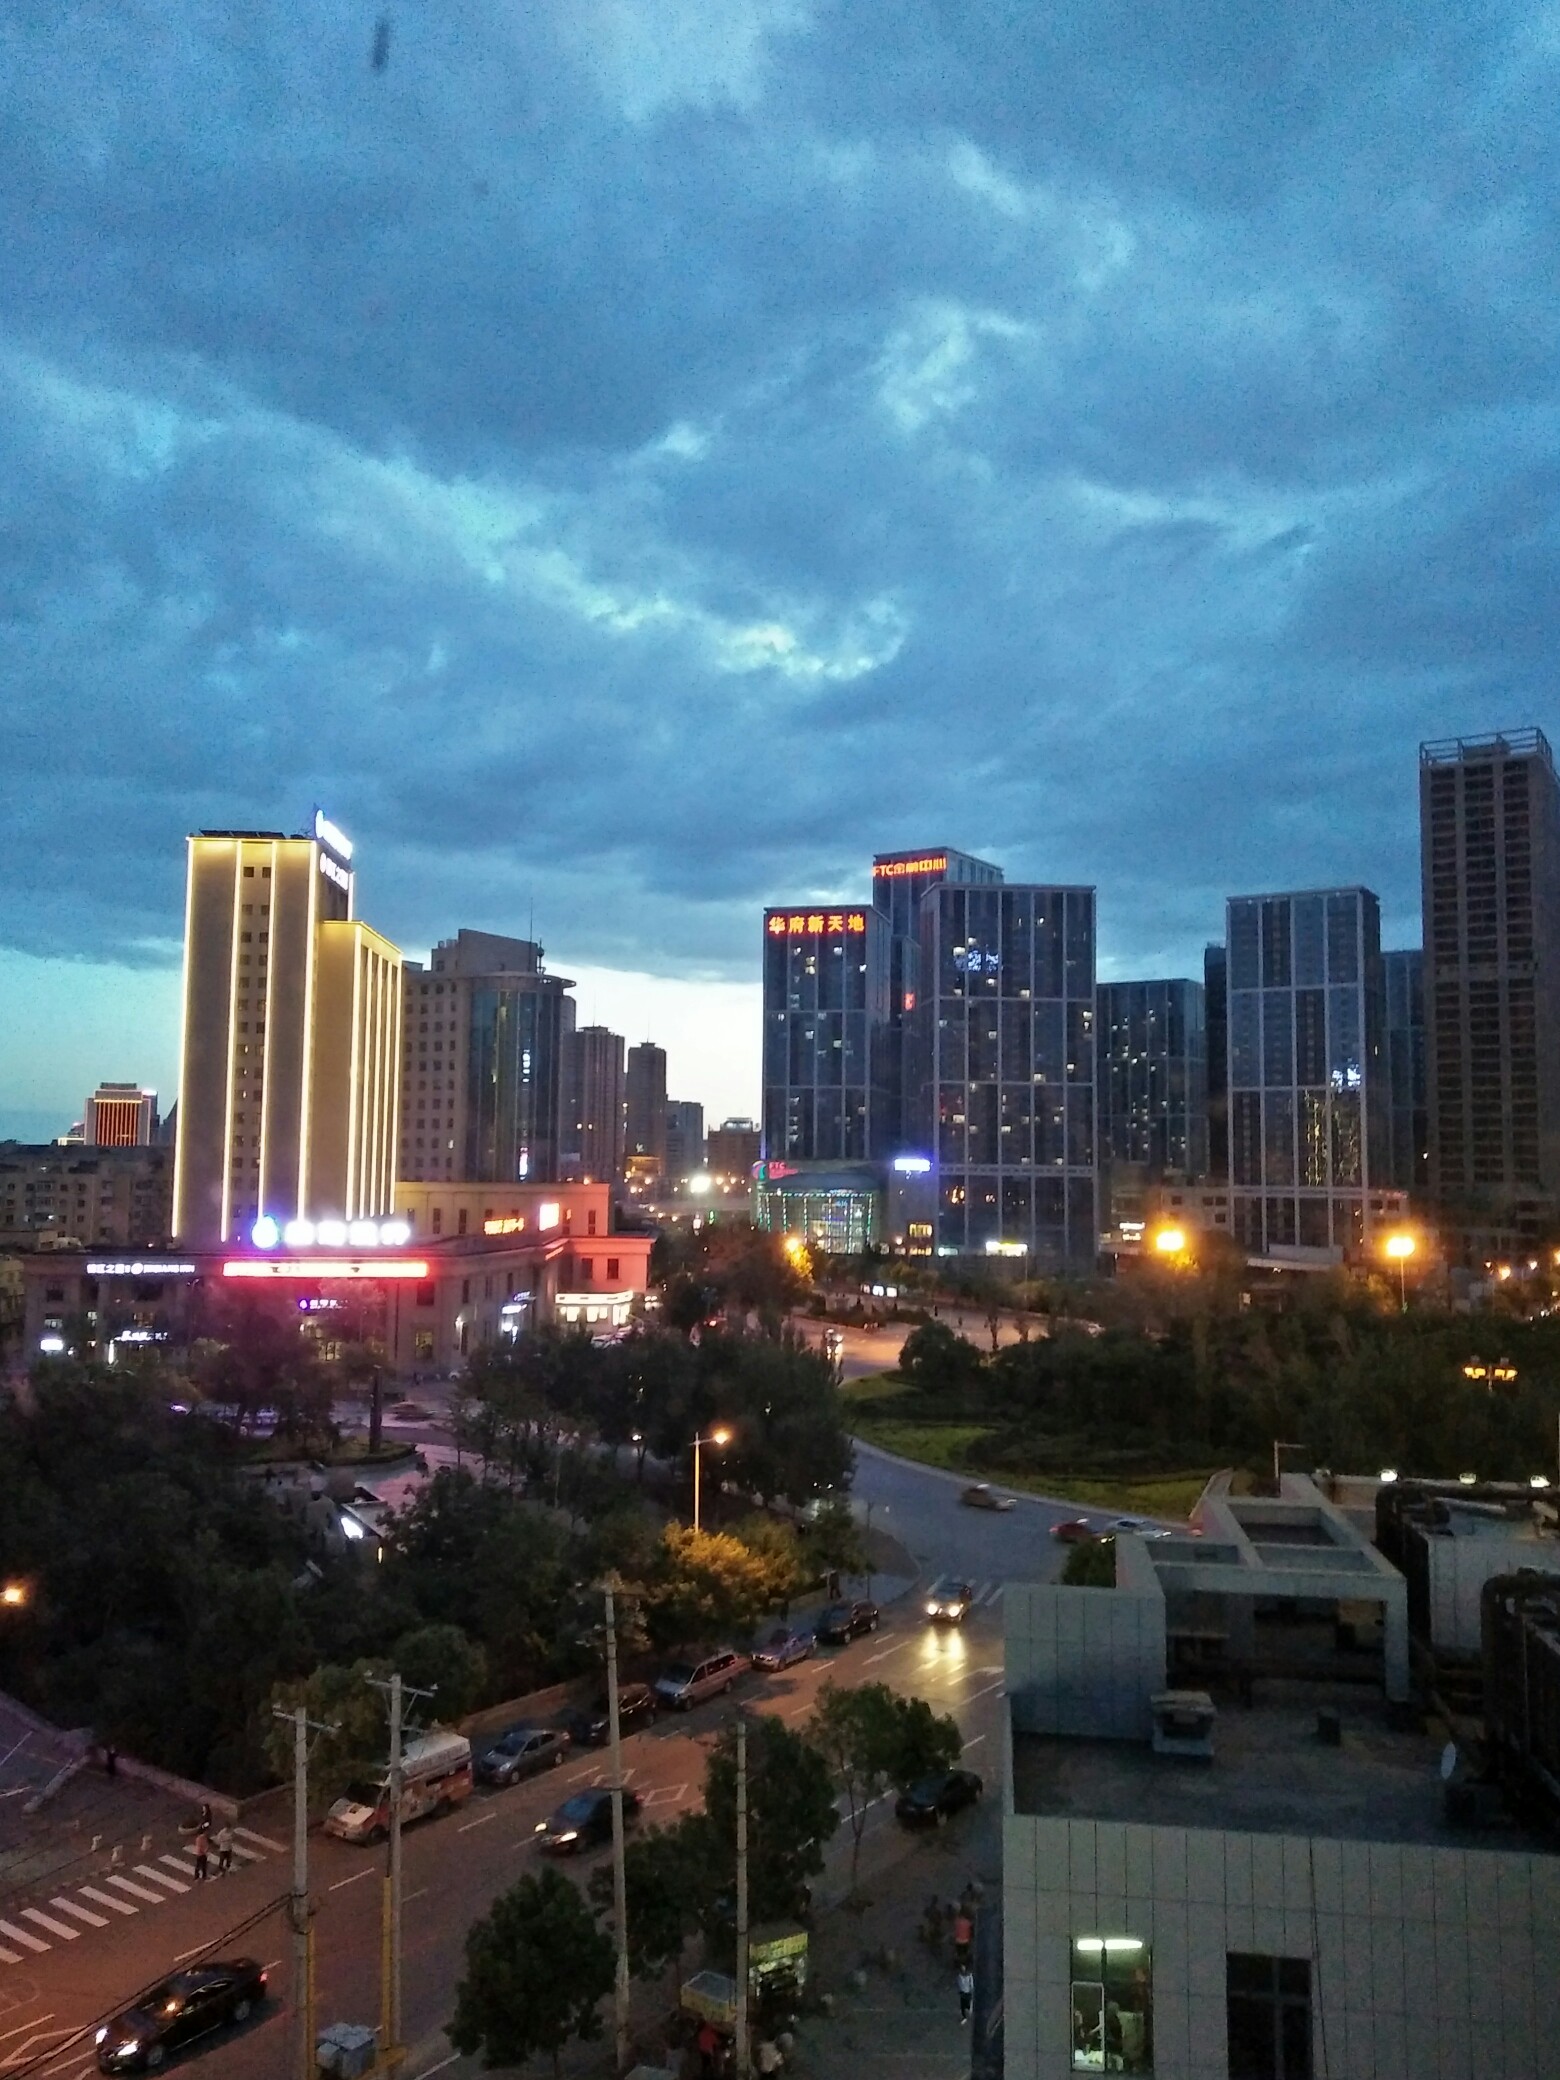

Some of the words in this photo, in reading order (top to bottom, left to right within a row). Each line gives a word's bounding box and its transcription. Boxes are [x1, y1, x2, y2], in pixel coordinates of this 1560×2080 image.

[769, 914, 864, 934] 华府新天地
